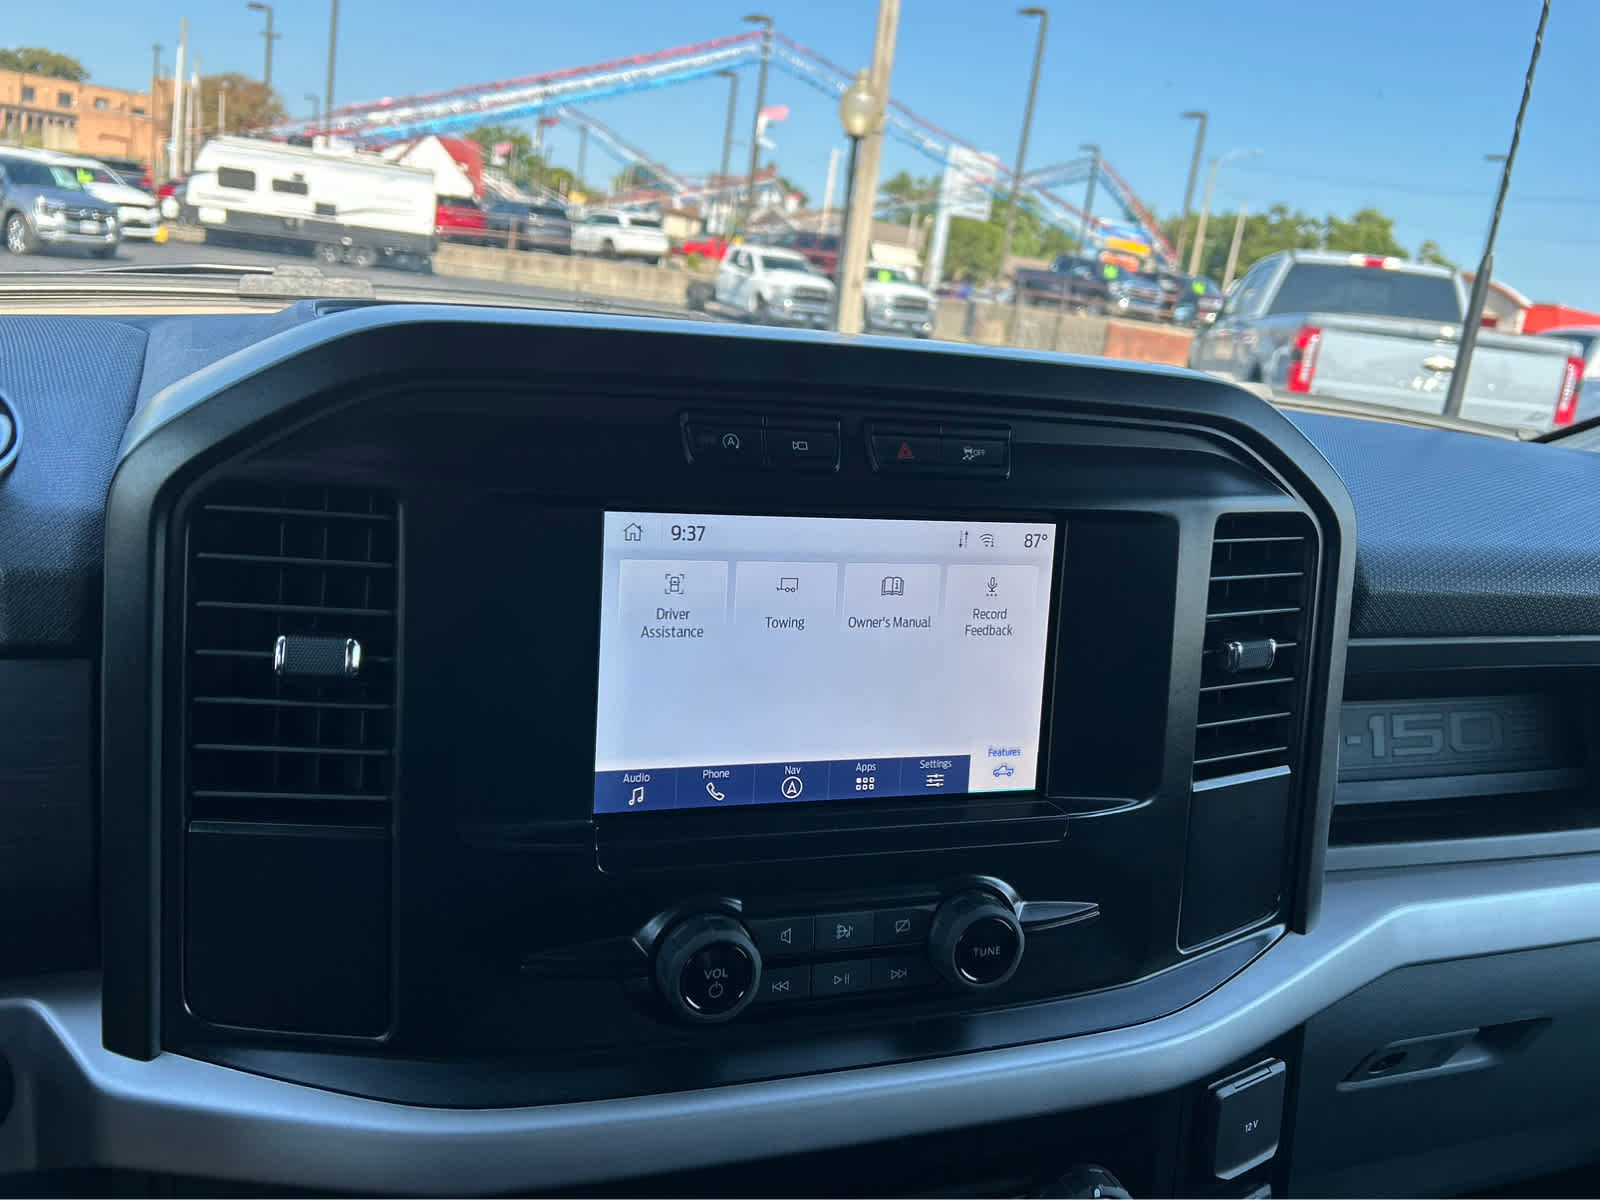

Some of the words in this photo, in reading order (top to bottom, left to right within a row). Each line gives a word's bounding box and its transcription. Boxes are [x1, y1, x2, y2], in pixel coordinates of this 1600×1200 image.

[671, 525, 706, 541] 9:37
[1024, 533, 1048, 548] 87°
[656, 607, 690, 620] Driver
[973, 608, 1007, 620] Record
[765, 616, 805, 630] Towing
[848, 616, 891, 629] Owner's
[893, 616, 931, 628] Manual
[640, 625, 704, 638] Assistance
[965, 624, 1013, 637] Feedback
[987, 747, 1021, 757] Features
[784, 765, 801, 775] Nav
[855, 762, 877, 773] Apps
[919, 759, 952, 770] Settings
[623, 773, 650, 783] Audio
[702, 769, 730, 779] Phone
[973, 946, 1001, 957] TUNE
[704, 968, 728, 980] VOL
